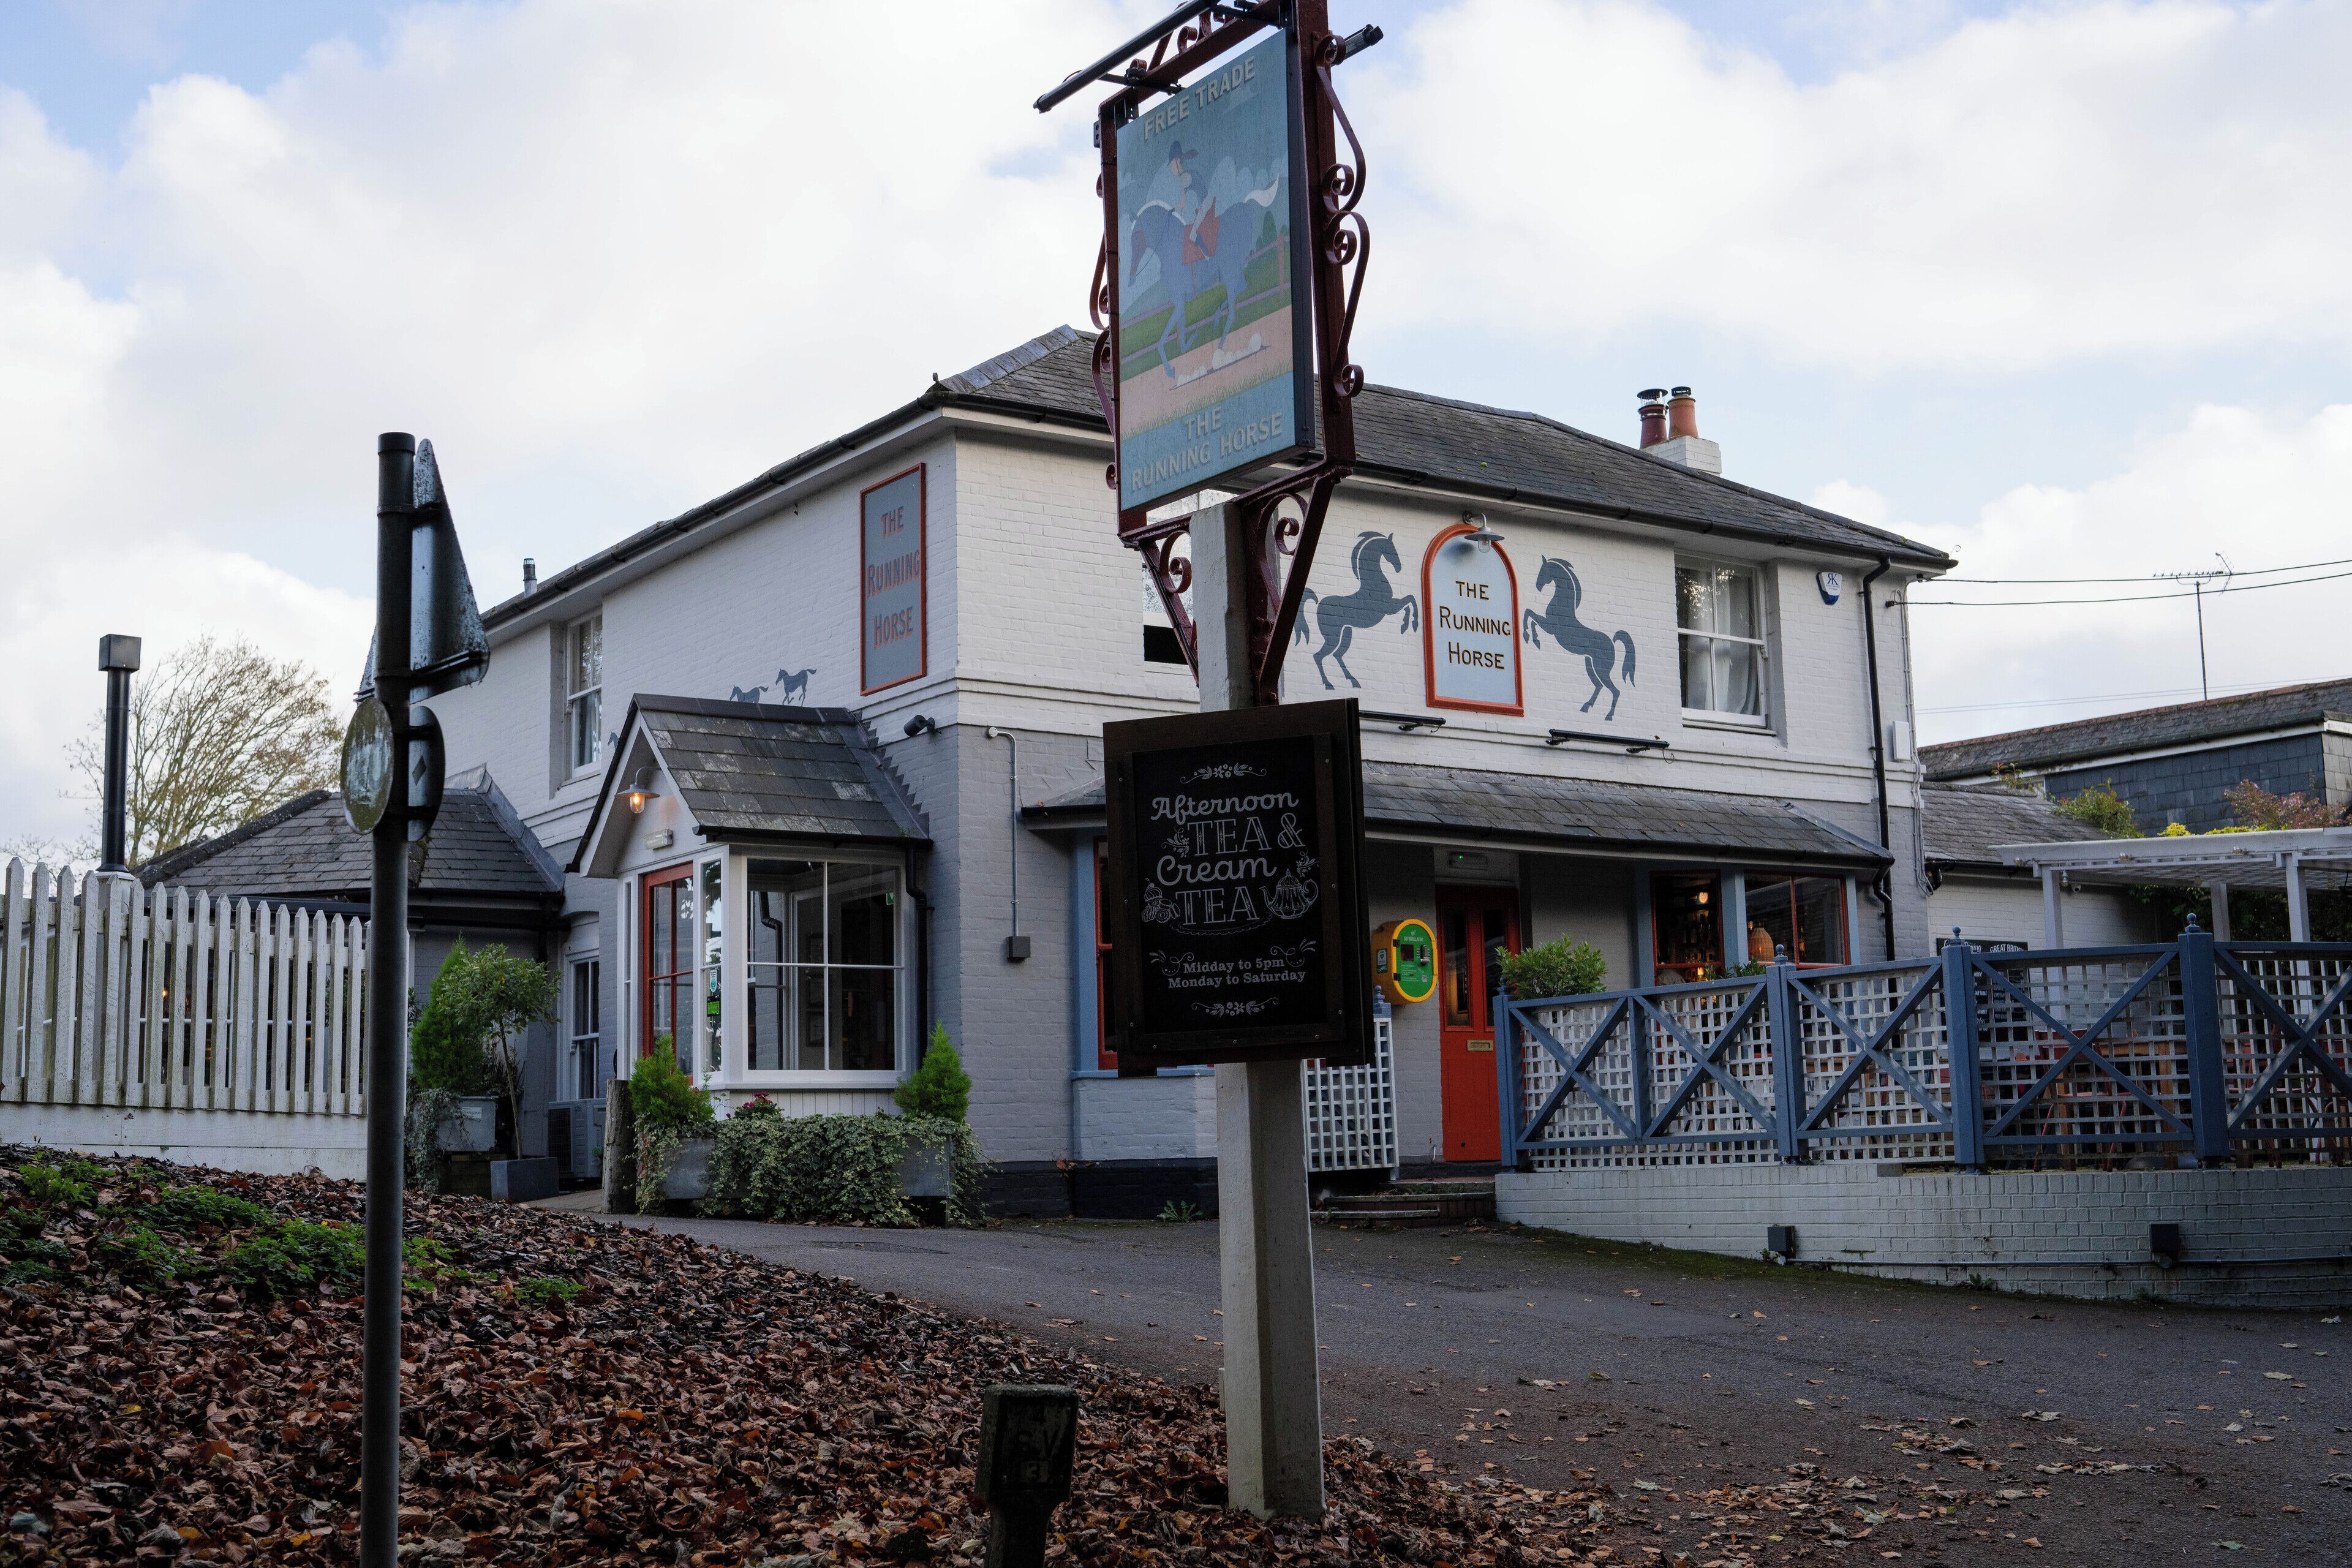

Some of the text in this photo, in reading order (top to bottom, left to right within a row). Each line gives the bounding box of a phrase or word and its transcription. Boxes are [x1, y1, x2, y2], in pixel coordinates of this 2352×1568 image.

[1144, 55, 1256, 143] FREE TRADE
[1185, 405, 1223, 442] THE
[1131, 411, 1283, 492] RUNNING HORSE
[881, 505, 905, 539] THE
[866, 549, 921, 598] RUNNING
[1455, 580, 1490, 600] THE
[873, 606, 914, 650] HORSE
[1439, 605, 1511, 636] RUNNING
[1448, 641, 1505, 670] HORSE
[1150, 792, 1299, 826] Afternoon
[1187, 812, 1306, 856] TEA &
[1156, 855, 1277, 886] Cream
[1175, 886, 1260, 925] TEA
[1990, 943, 2006, 953] GREAT
[1167, 970, 1306, 989] Monday to Saturday
[1183, 958, 1284, 974] Midday to 5pm
